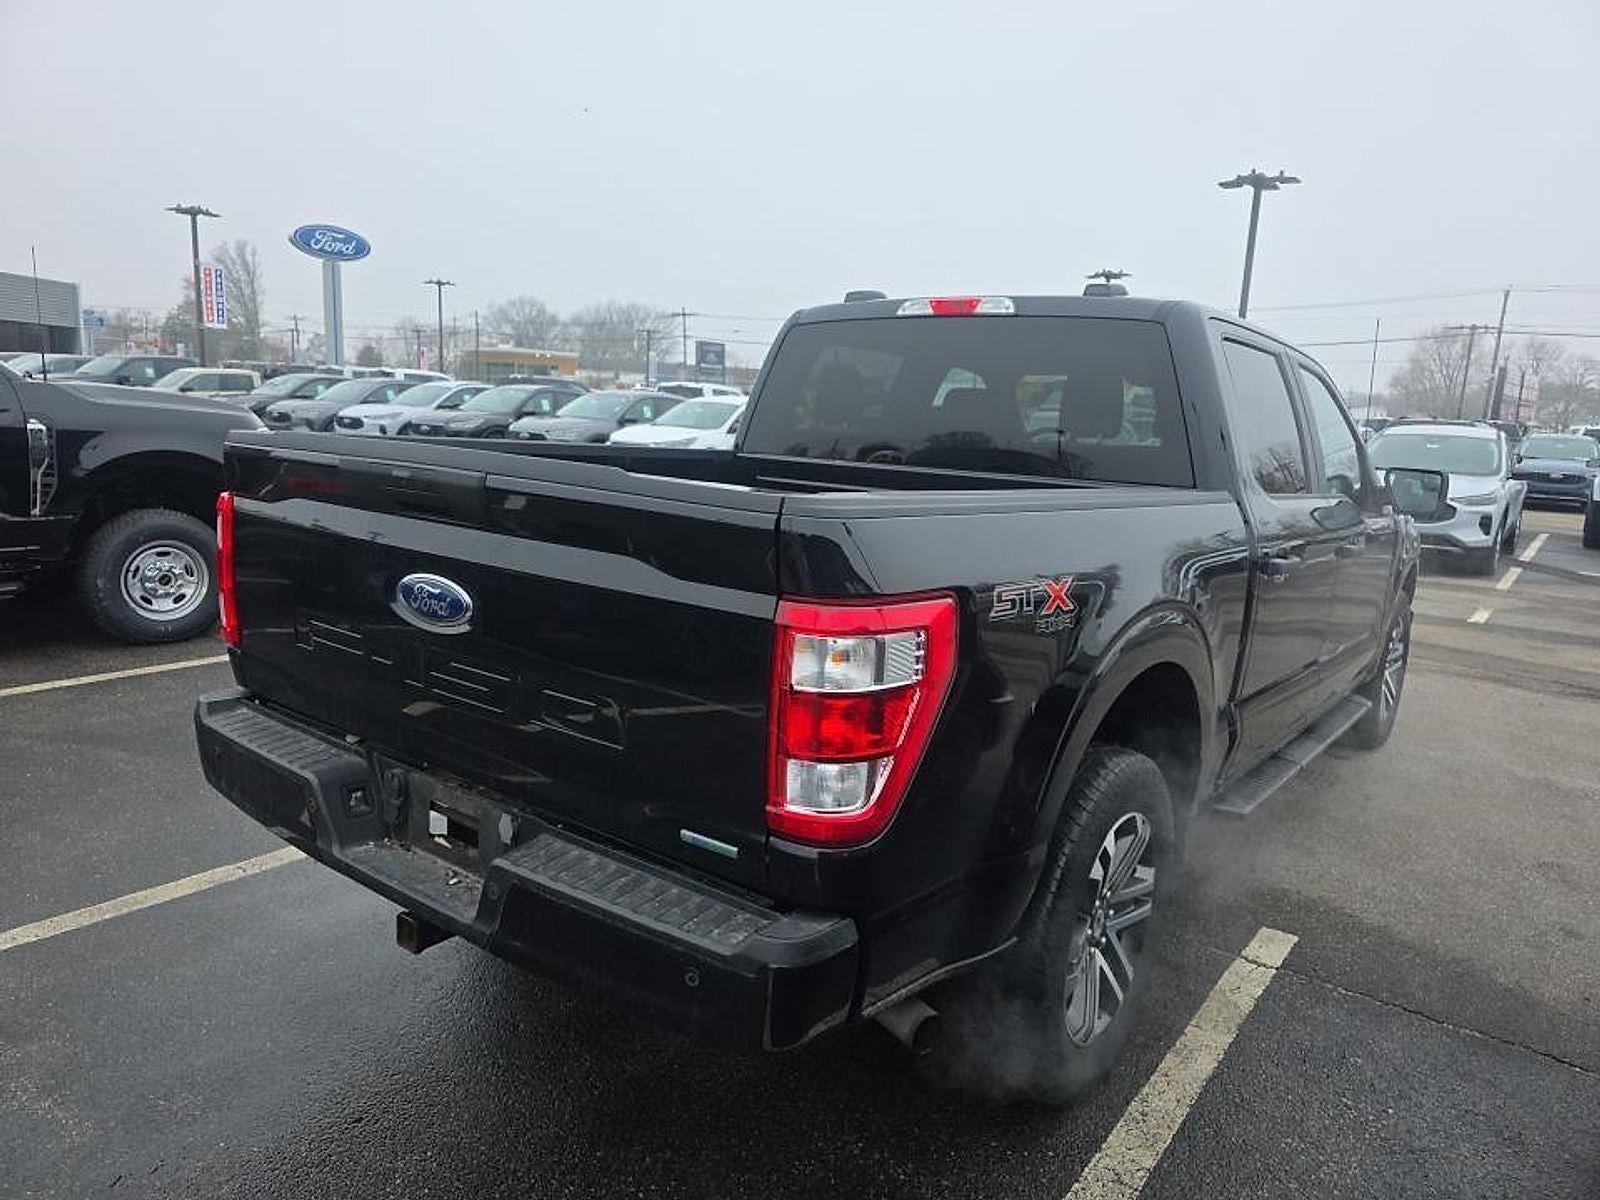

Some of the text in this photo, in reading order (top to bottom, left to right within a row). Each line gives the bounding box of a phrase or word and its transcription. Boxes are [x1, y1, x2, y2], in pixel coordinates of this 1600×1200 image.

[310, 230, 357, 255] Ford
[409, 583, 451, 616] Ford
[990, 575, 1075, 618] STX
